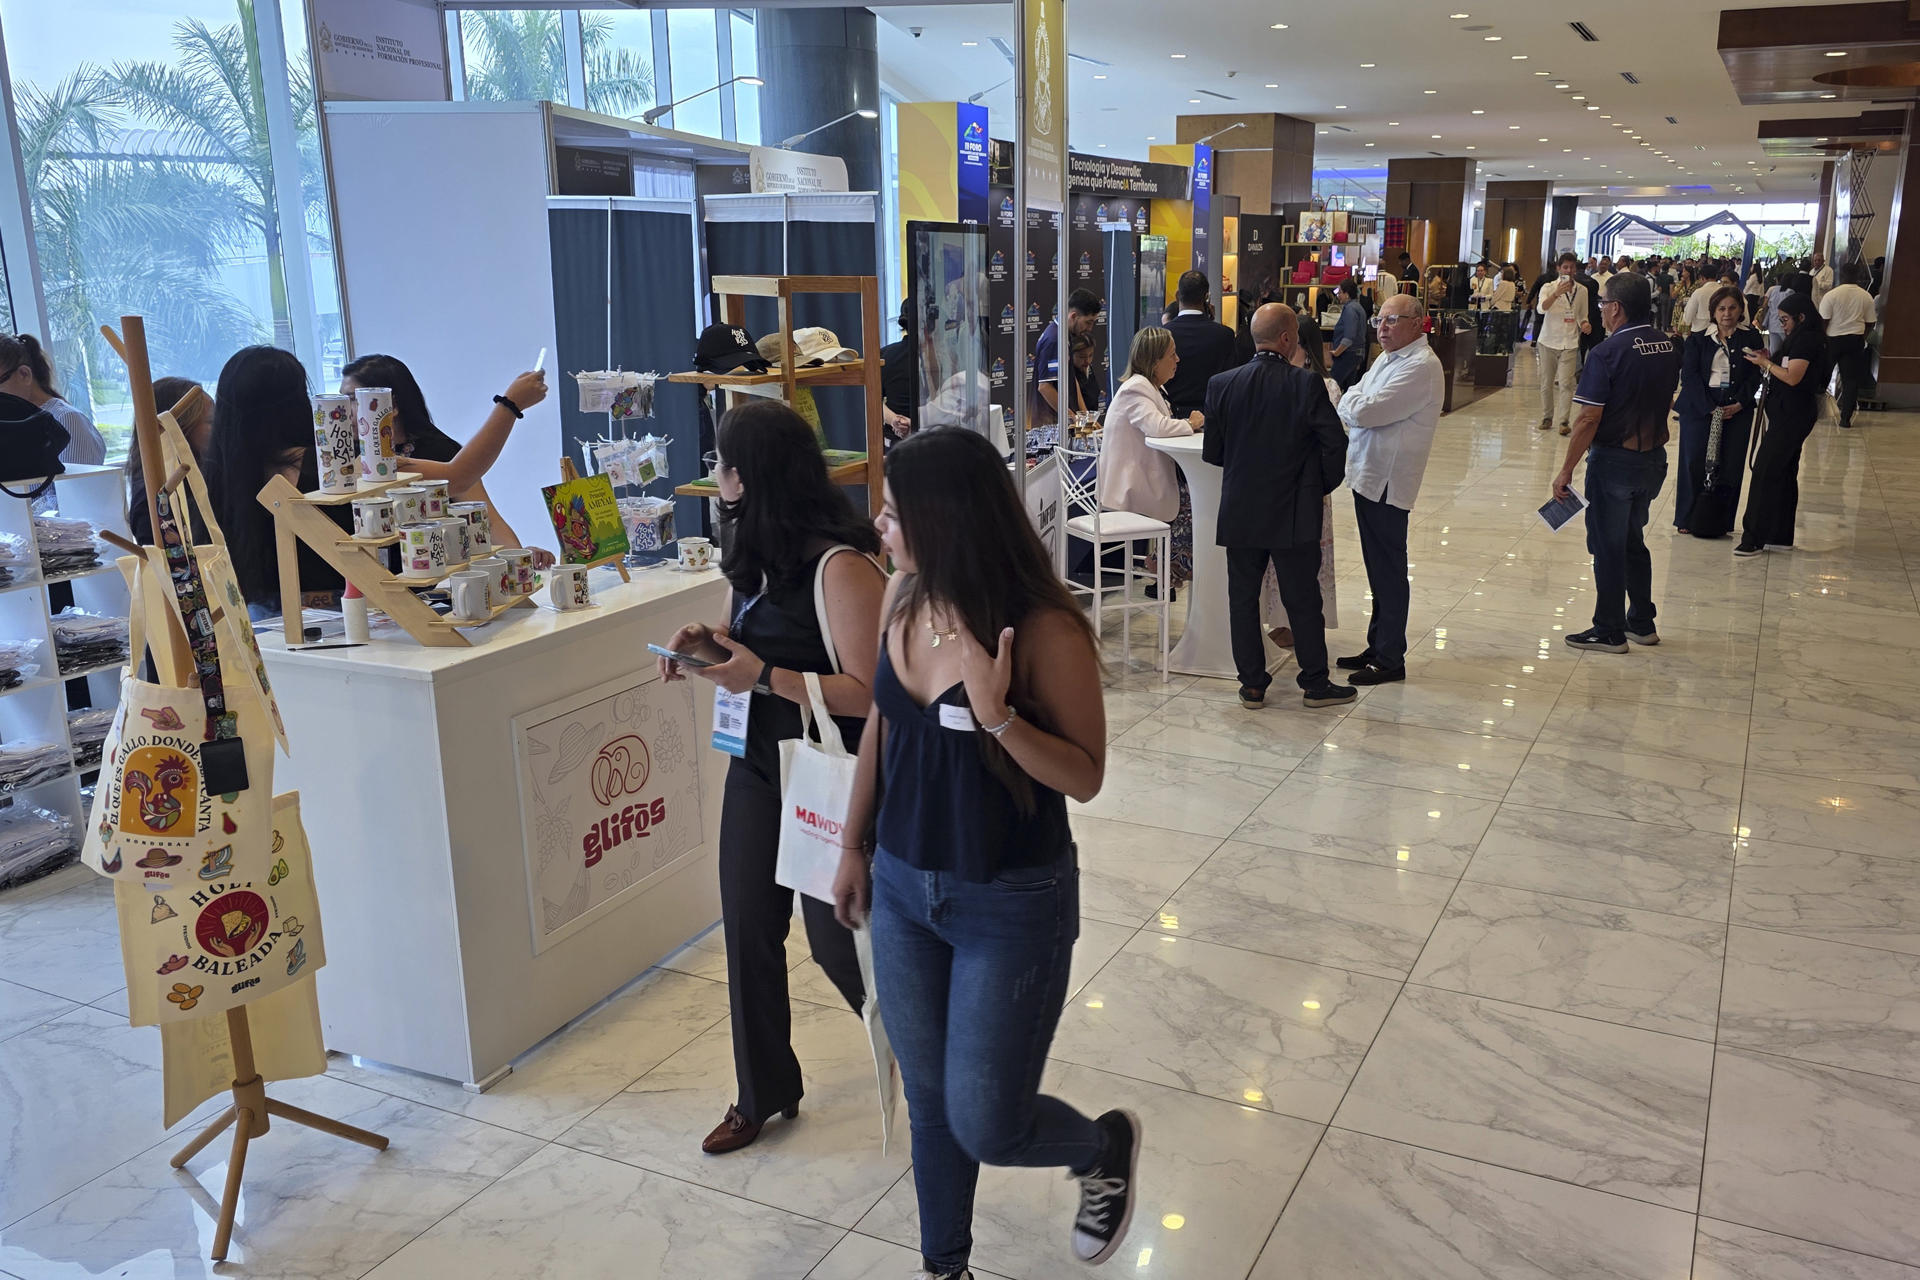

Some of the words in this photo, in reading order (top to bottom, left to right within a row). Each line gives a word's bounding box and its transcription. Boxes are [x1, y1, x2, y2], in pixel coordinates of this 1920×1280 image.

[375, 35, 404, 47] INSTITUTO
[376, 43, 402, 56] NACIONAL
[1070, 157, 1106, 177] Tecnología
[1105, 165, 1111, 178] y
[1111, 163, 1142, 178] Desarrollo:
[1091, 177, 1103, 191] que
[1130, 179, 1158, 193] Territorios
[1253, 229, 1259, 241] D
[152, 735, 200, 761] DONDE
[114, 766, 123, 782] ES
[112, 784, 122, 809] QUE
[110, 809, 119, 826] EL
[192, 931, 283, 976] BALEADA
